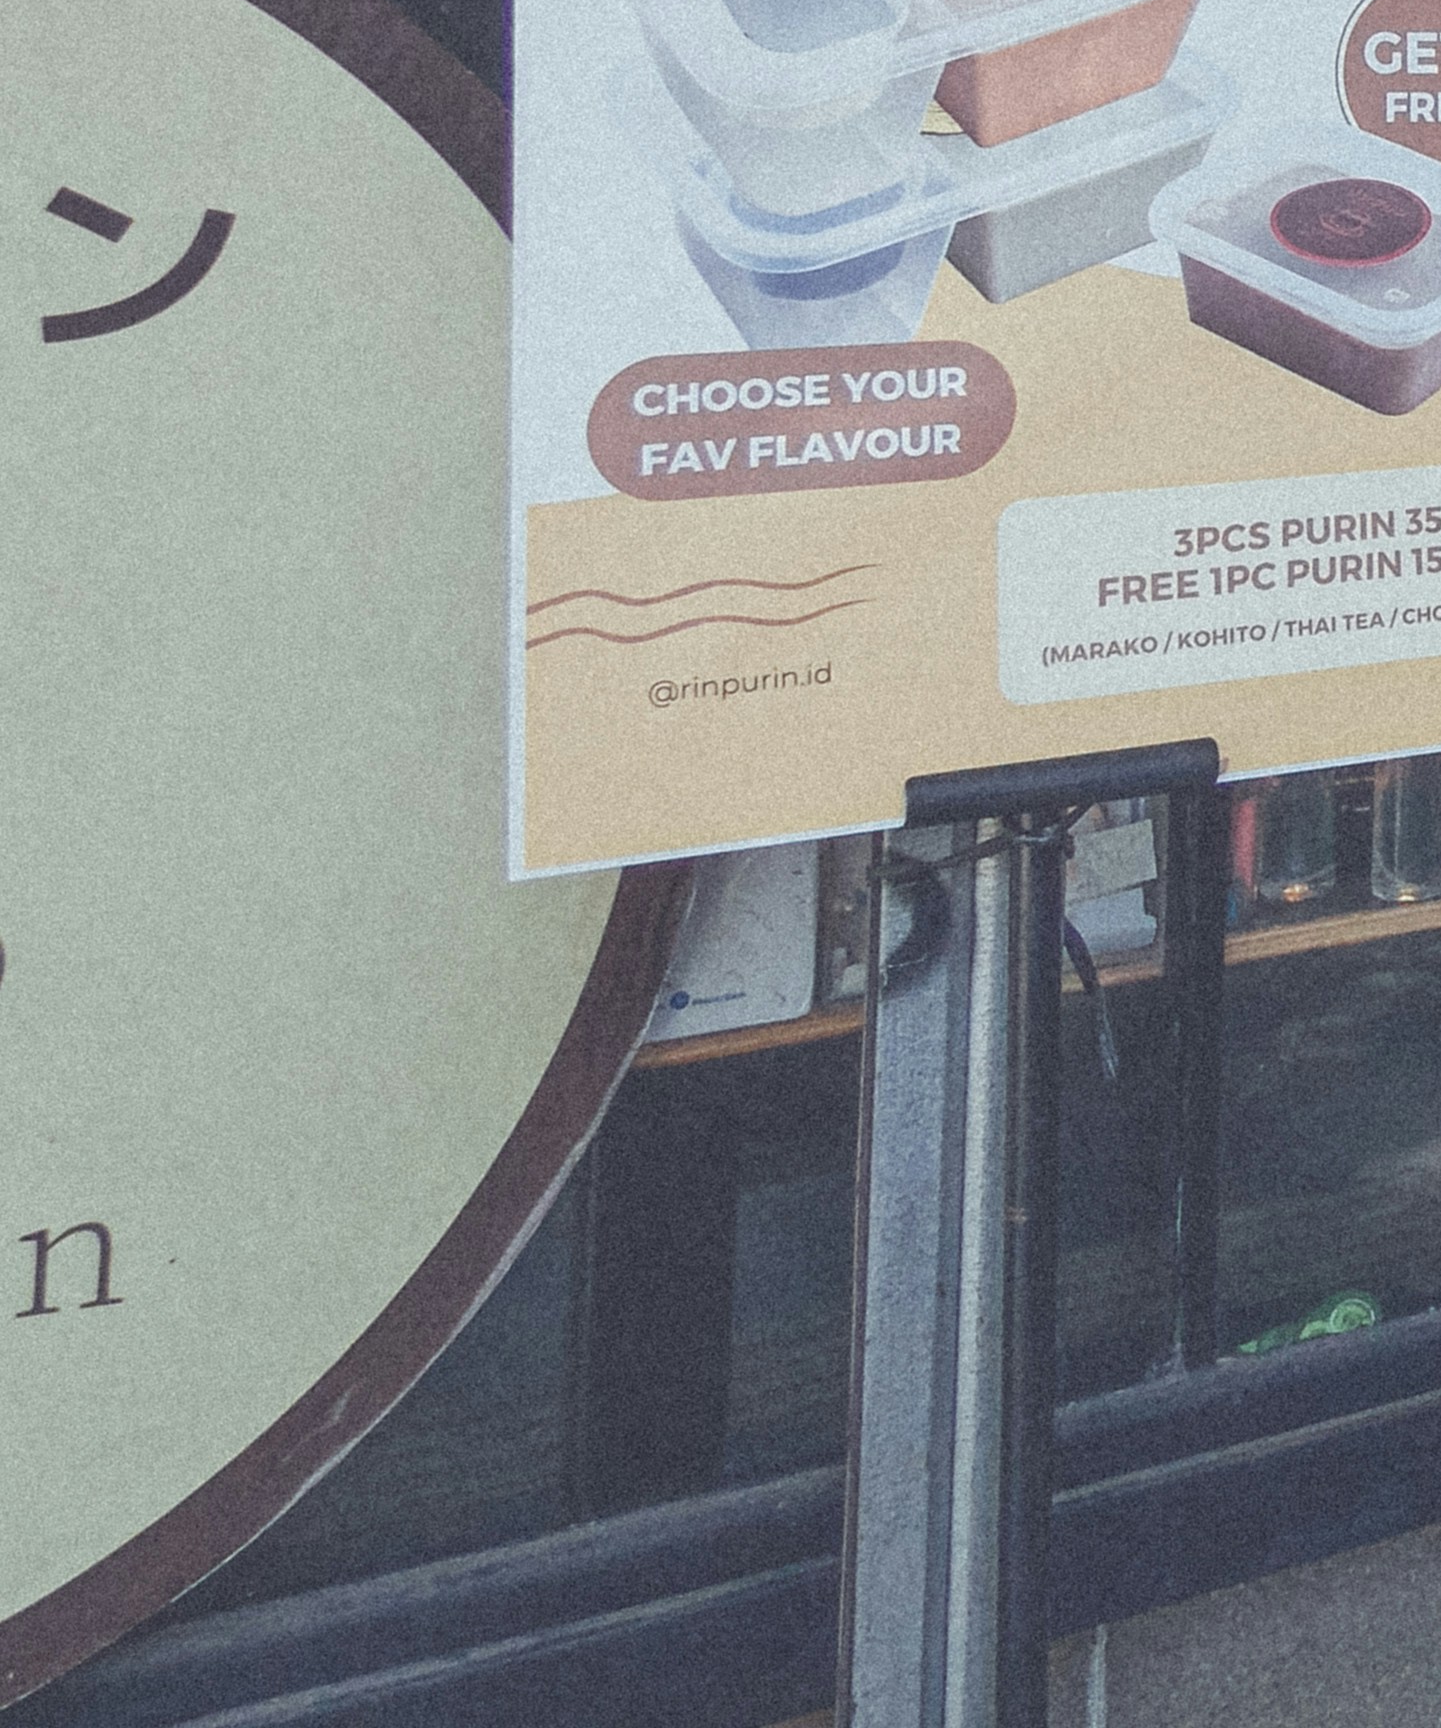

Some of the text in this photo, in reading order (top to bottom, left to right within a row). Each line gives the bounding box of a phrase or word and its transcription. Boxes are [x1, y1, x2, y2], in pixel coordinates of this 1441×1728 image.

[40, 186, 236, 344] ン
[631, 364, 968, 418] CHOOSE YOUR
[640, 422, 962, 476] FAV FLAVOUR
[1173, 519, 1272, 559] 3PCS
[1279, 508, 1397, 550] PURIN
[1096, 566, 1200, 608] FREE
[1209, 559, 1276, 597] 1PC
[1284, 549, 1401, 591] PURIN
[1042, 636, 1158, 667] (MARAKO
[1178, 624, 1267, 650] KOHITO
[1284, 616, 1337, 638] THAI
[1342, 611, 1385, 632] TEA
[648, 661, 833, 709] @rinpurin.id
[15, 1214, 124, 1320] n
